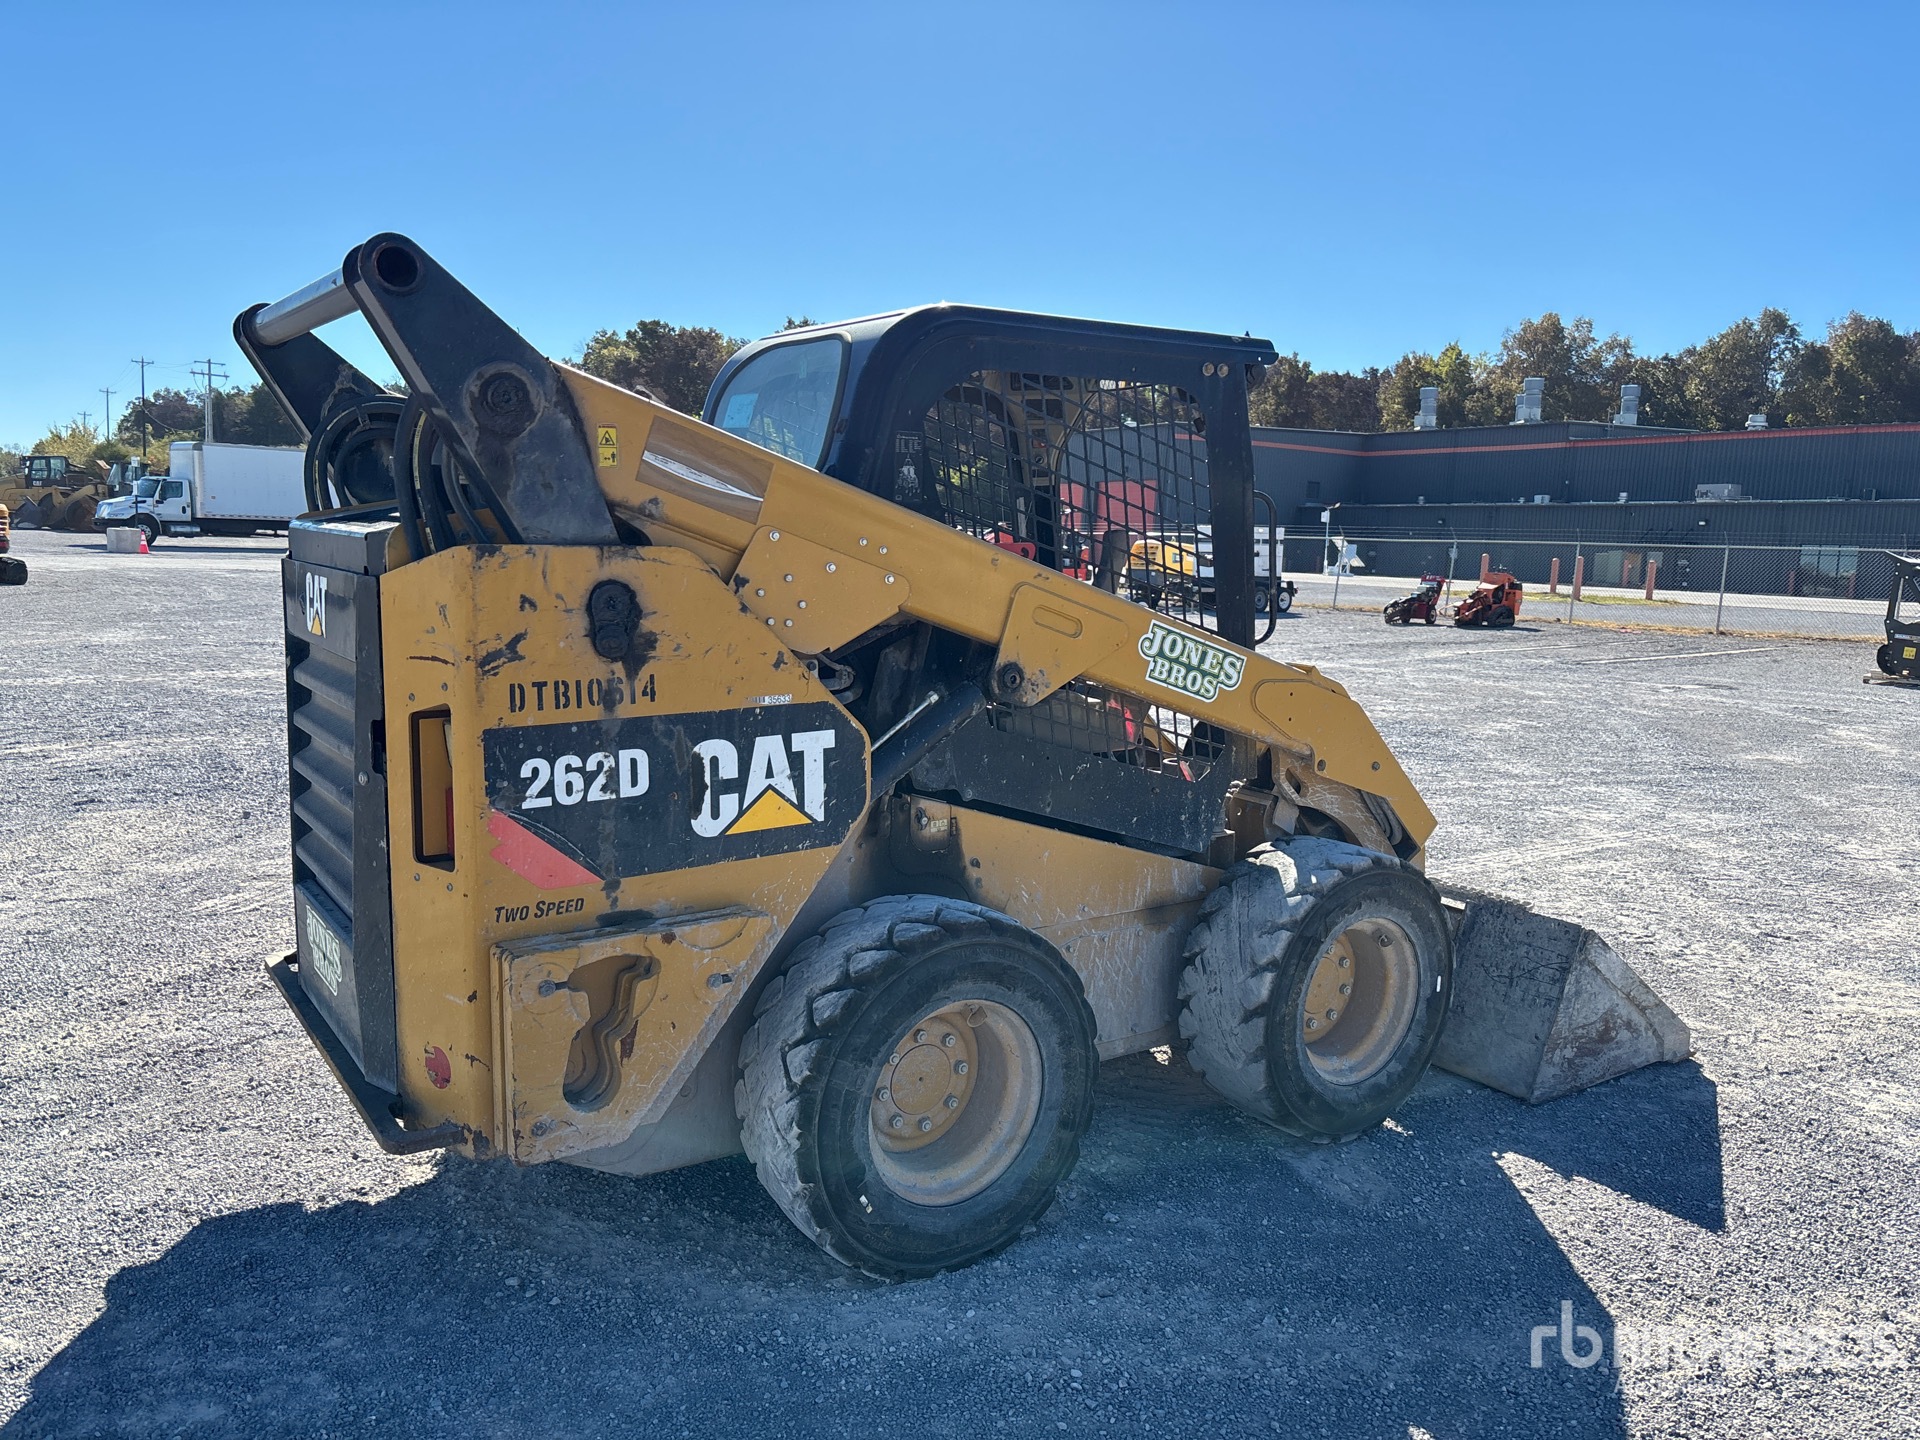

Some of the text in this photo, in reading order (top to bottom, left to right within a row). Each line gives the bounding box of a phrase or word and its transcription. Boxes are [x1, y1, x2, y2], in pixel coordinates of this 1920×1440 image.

[306, 572, 327, 638] CAT
[1141, 626, 1241, 686] JONES
[1150, 656, 1217, 698] BROS
[520, 748, 649, 809] 262D
[691, 729, 835, 837] CAT
